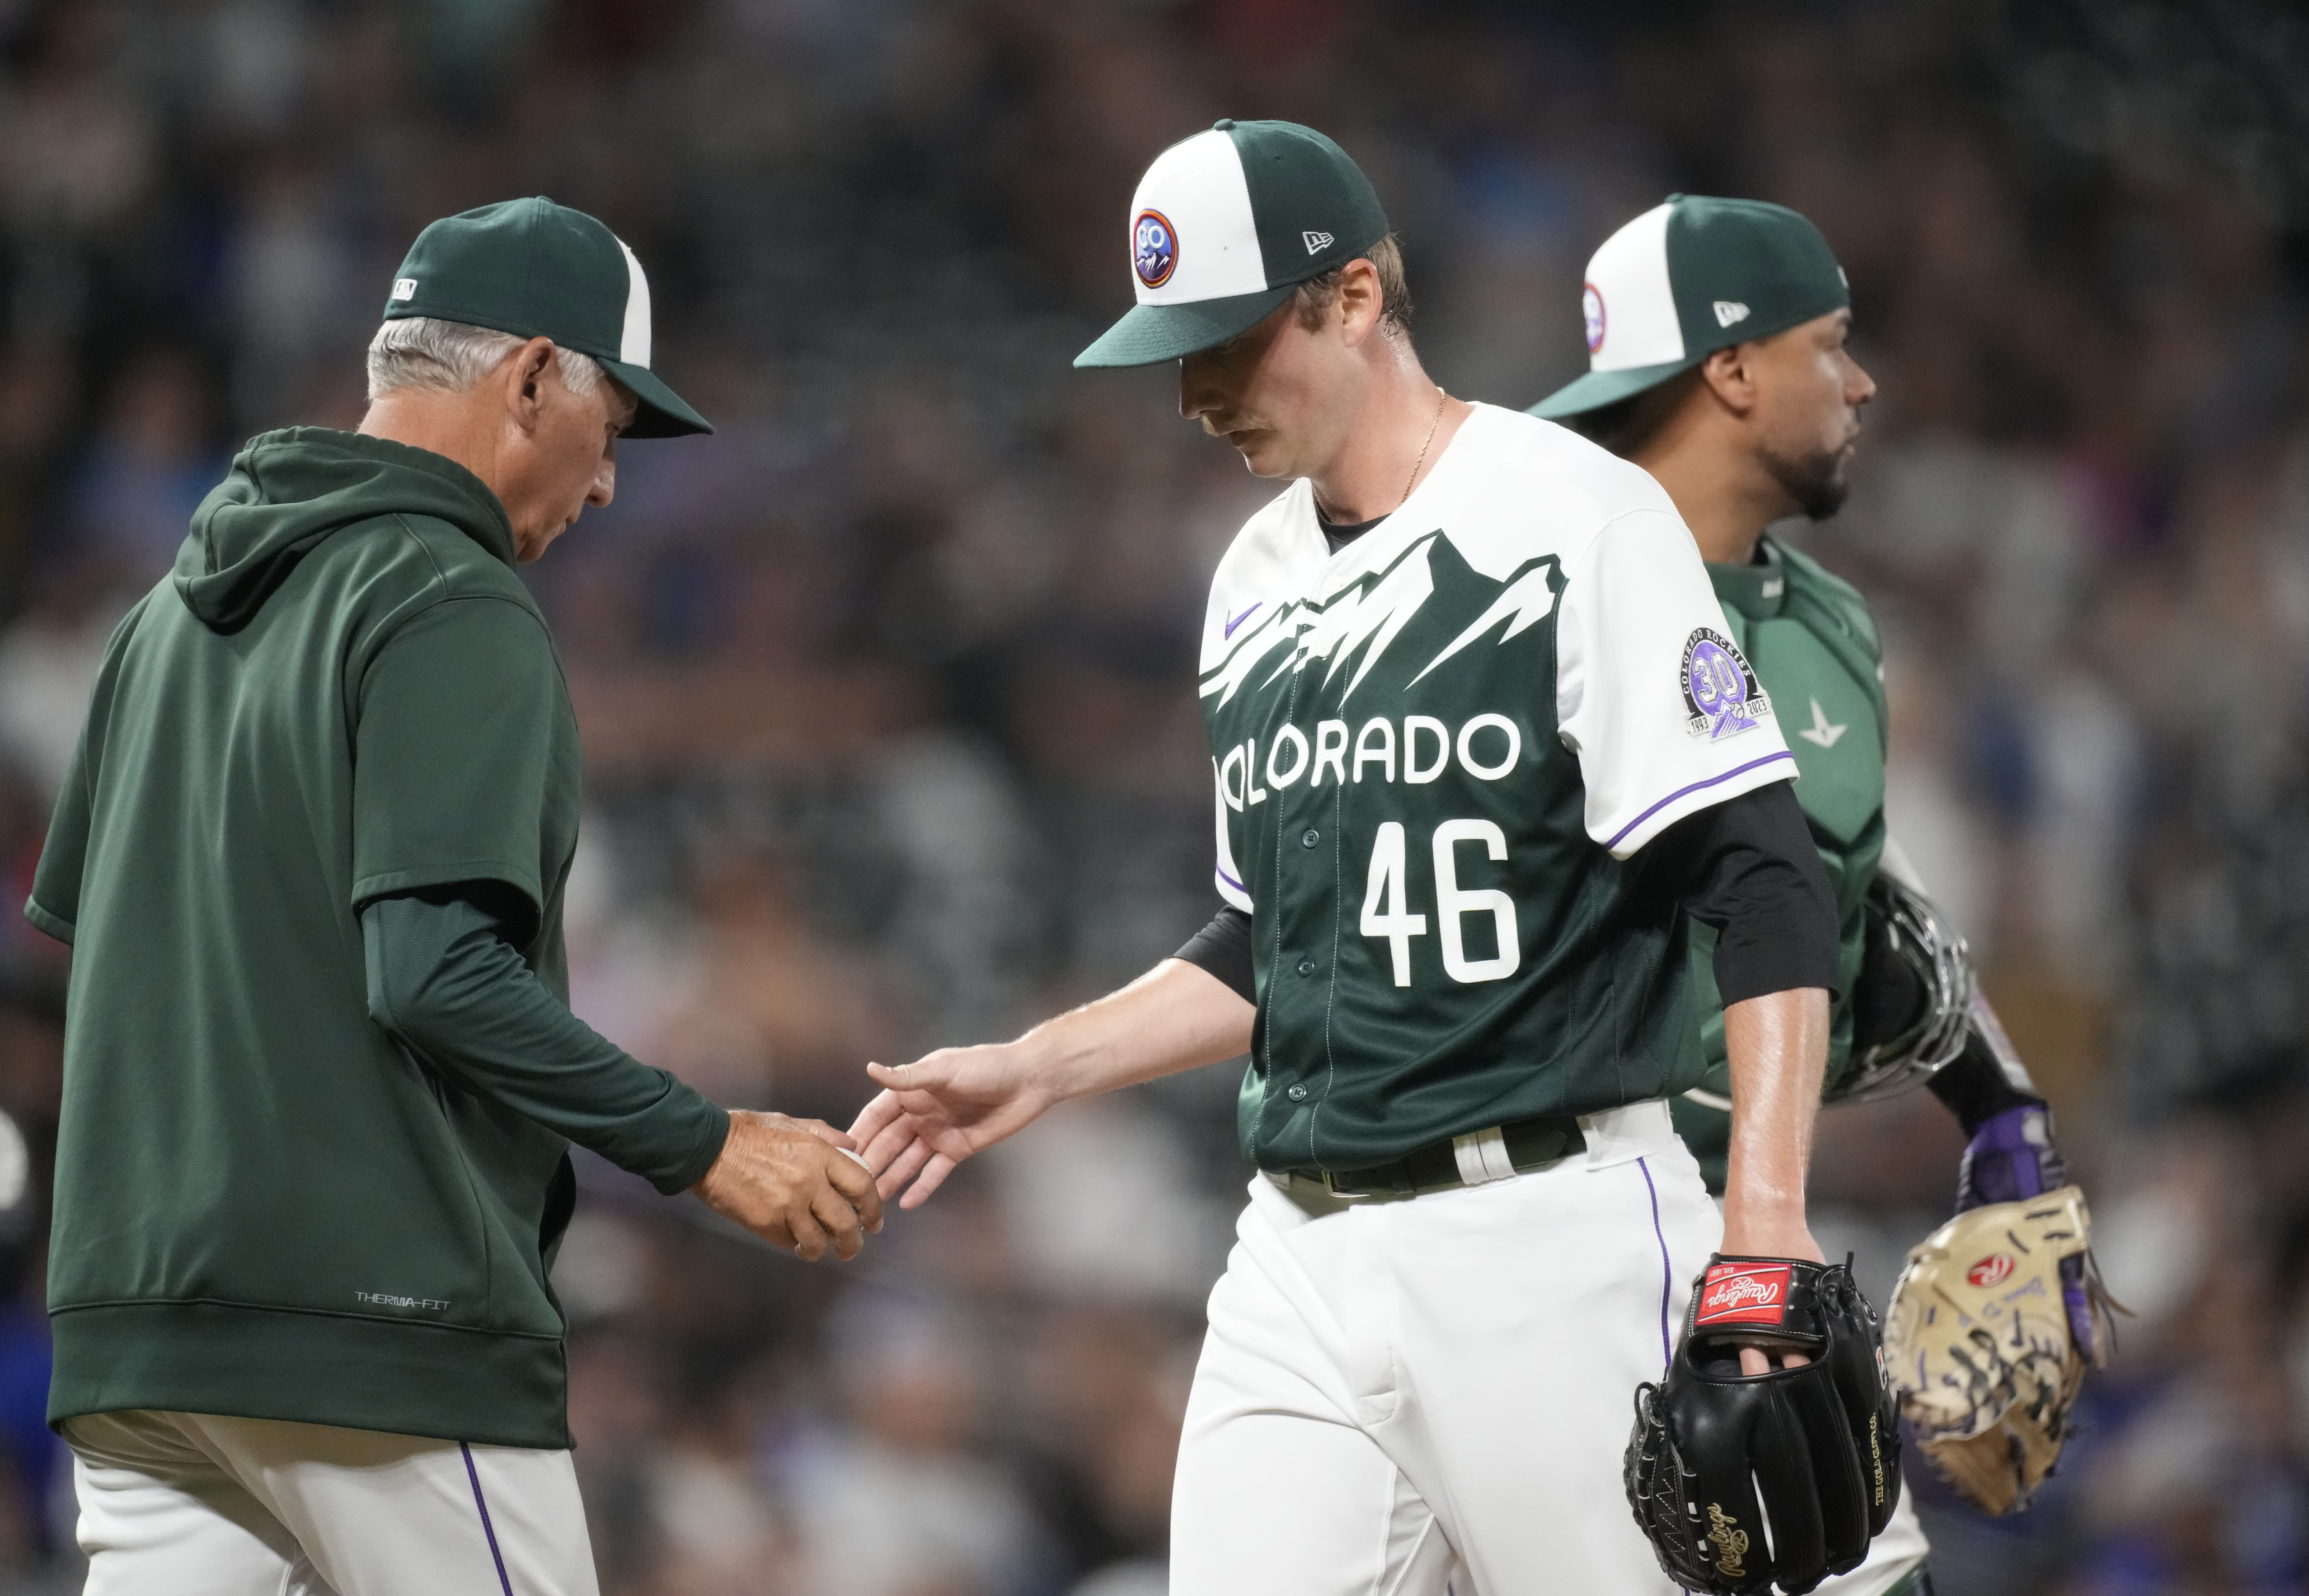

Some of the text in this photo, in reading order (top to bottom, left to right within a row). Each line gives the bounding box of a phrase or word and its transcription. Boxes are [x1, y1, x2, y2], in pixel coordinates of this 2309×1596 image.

[1136, 225, 1164, 249] CO
[1681, 629, 1751, 695] COLORADO ROCKIES
[1693, 652, 1740, 704] 30
[1747, 699, 1767, 715] 2023
[1691, 717, 1709, 732] 1993
[1212, 713, 1521, 812] OLORADO
[1360, 819, 1521, 987] 46
[355, 1291, 451, 1310] THERMA-FIT
[1707, 1283, 1778, 1307] Rawlings
[1874, 1459, 1883, 1486] GOLD
[1875, 1485, 1883, 1506] THE
[1707, 1502, 1746, 1577] Rawlings
